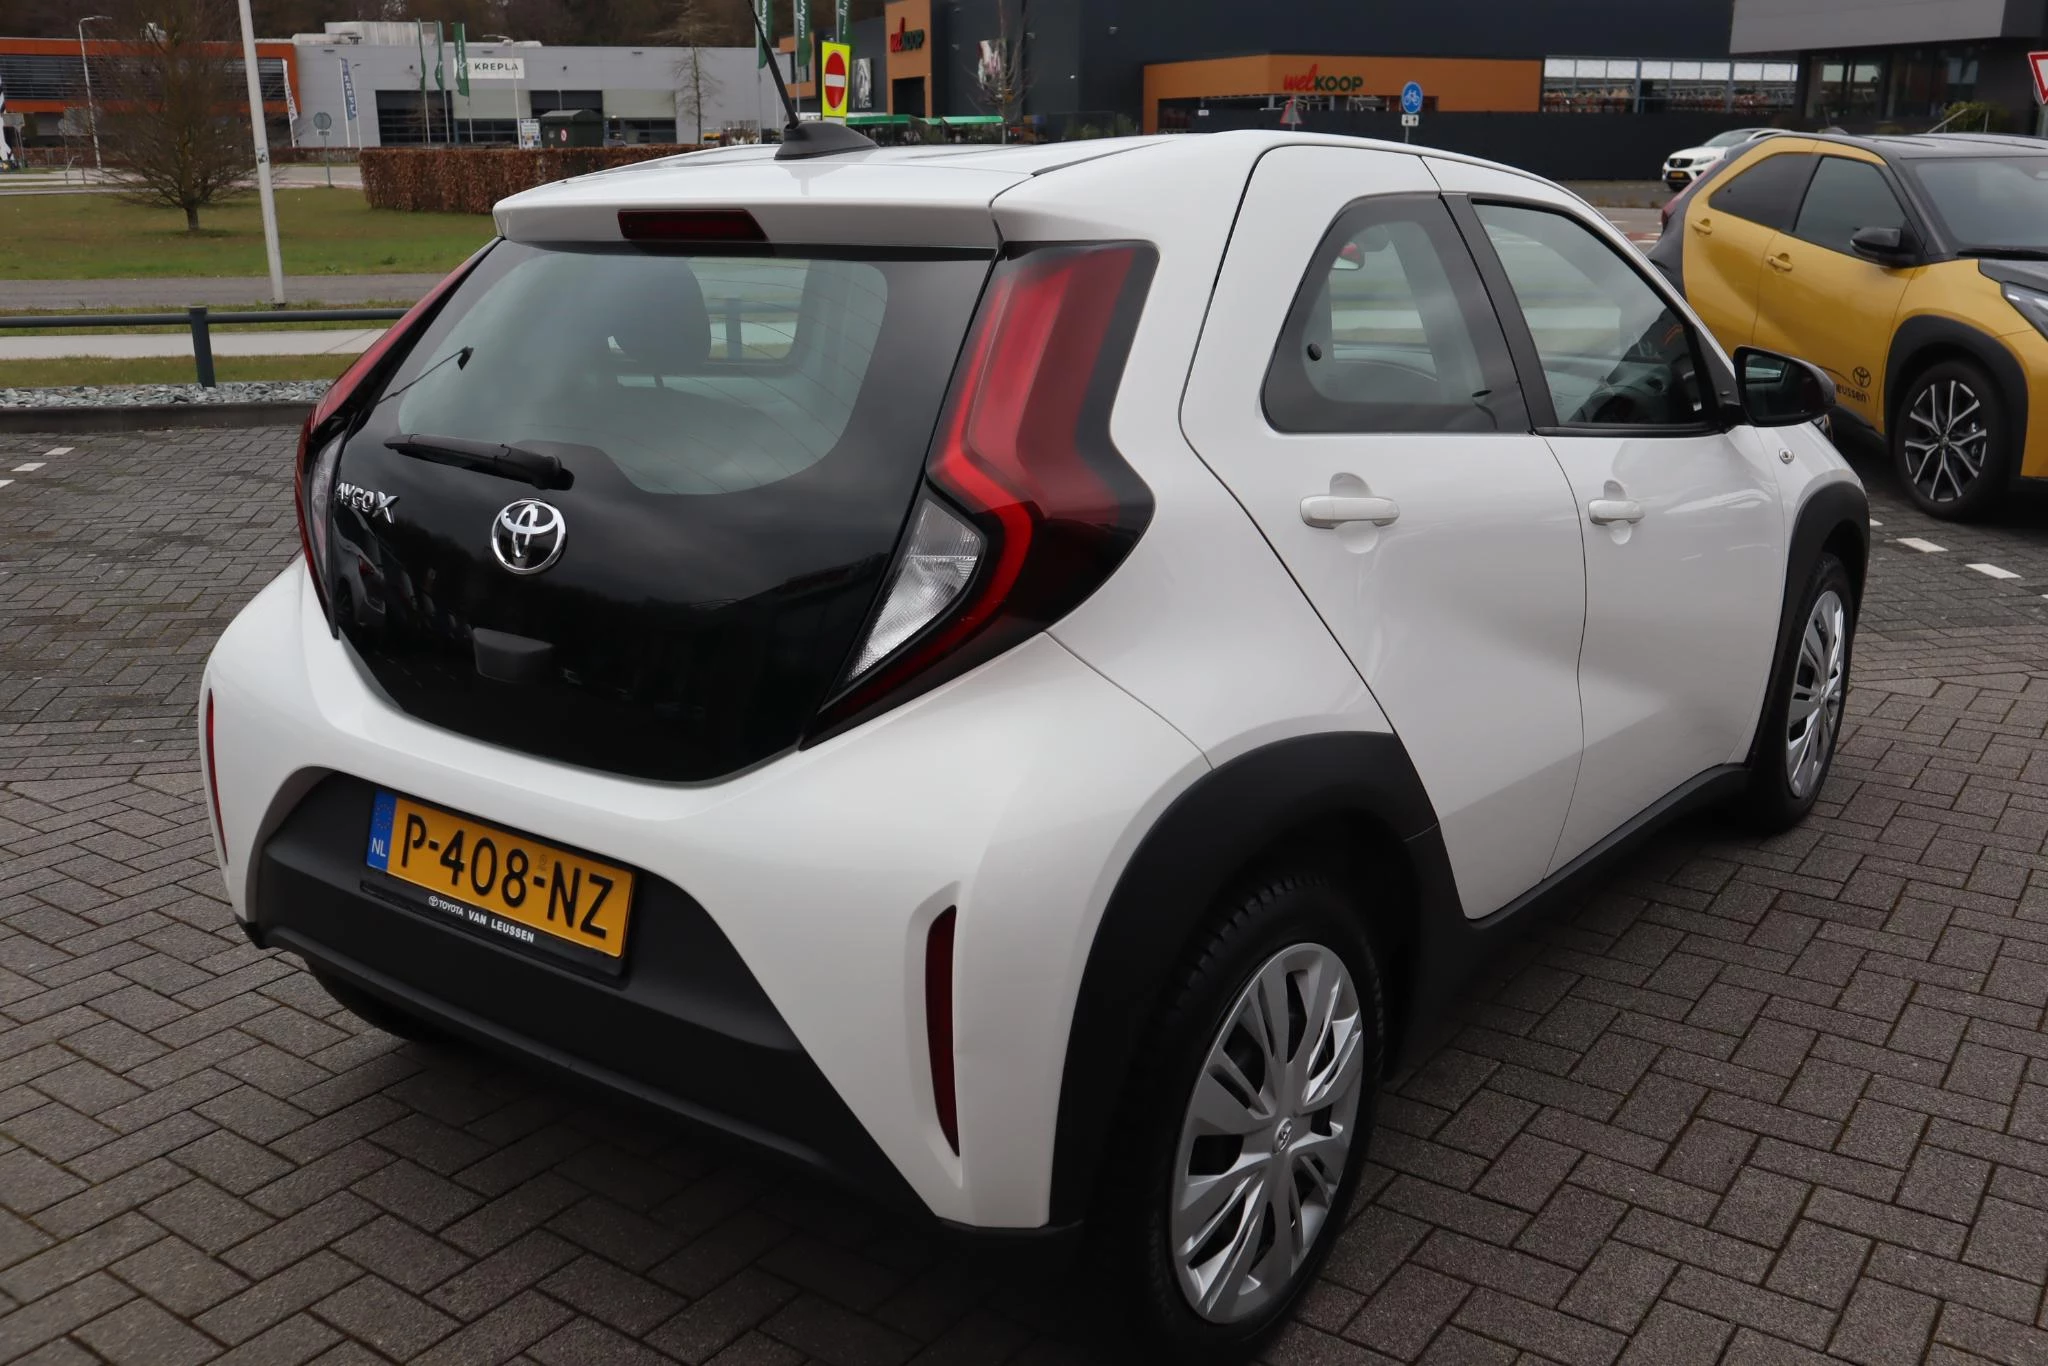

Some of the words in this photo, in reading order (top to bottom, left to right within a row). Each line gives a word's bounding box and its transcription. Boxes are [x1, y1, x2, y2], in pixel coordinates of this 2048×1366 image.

[474, 63, 519, 71] KREPLA
[371, 837, 387, 858] NL
[401, 812, 615, 940] P-408-NZ
[438, 899, 464, 917] TOYOTA
[468, 909, 488, 926] VAN
[491, 919, 535, 944] LEUSSEN
